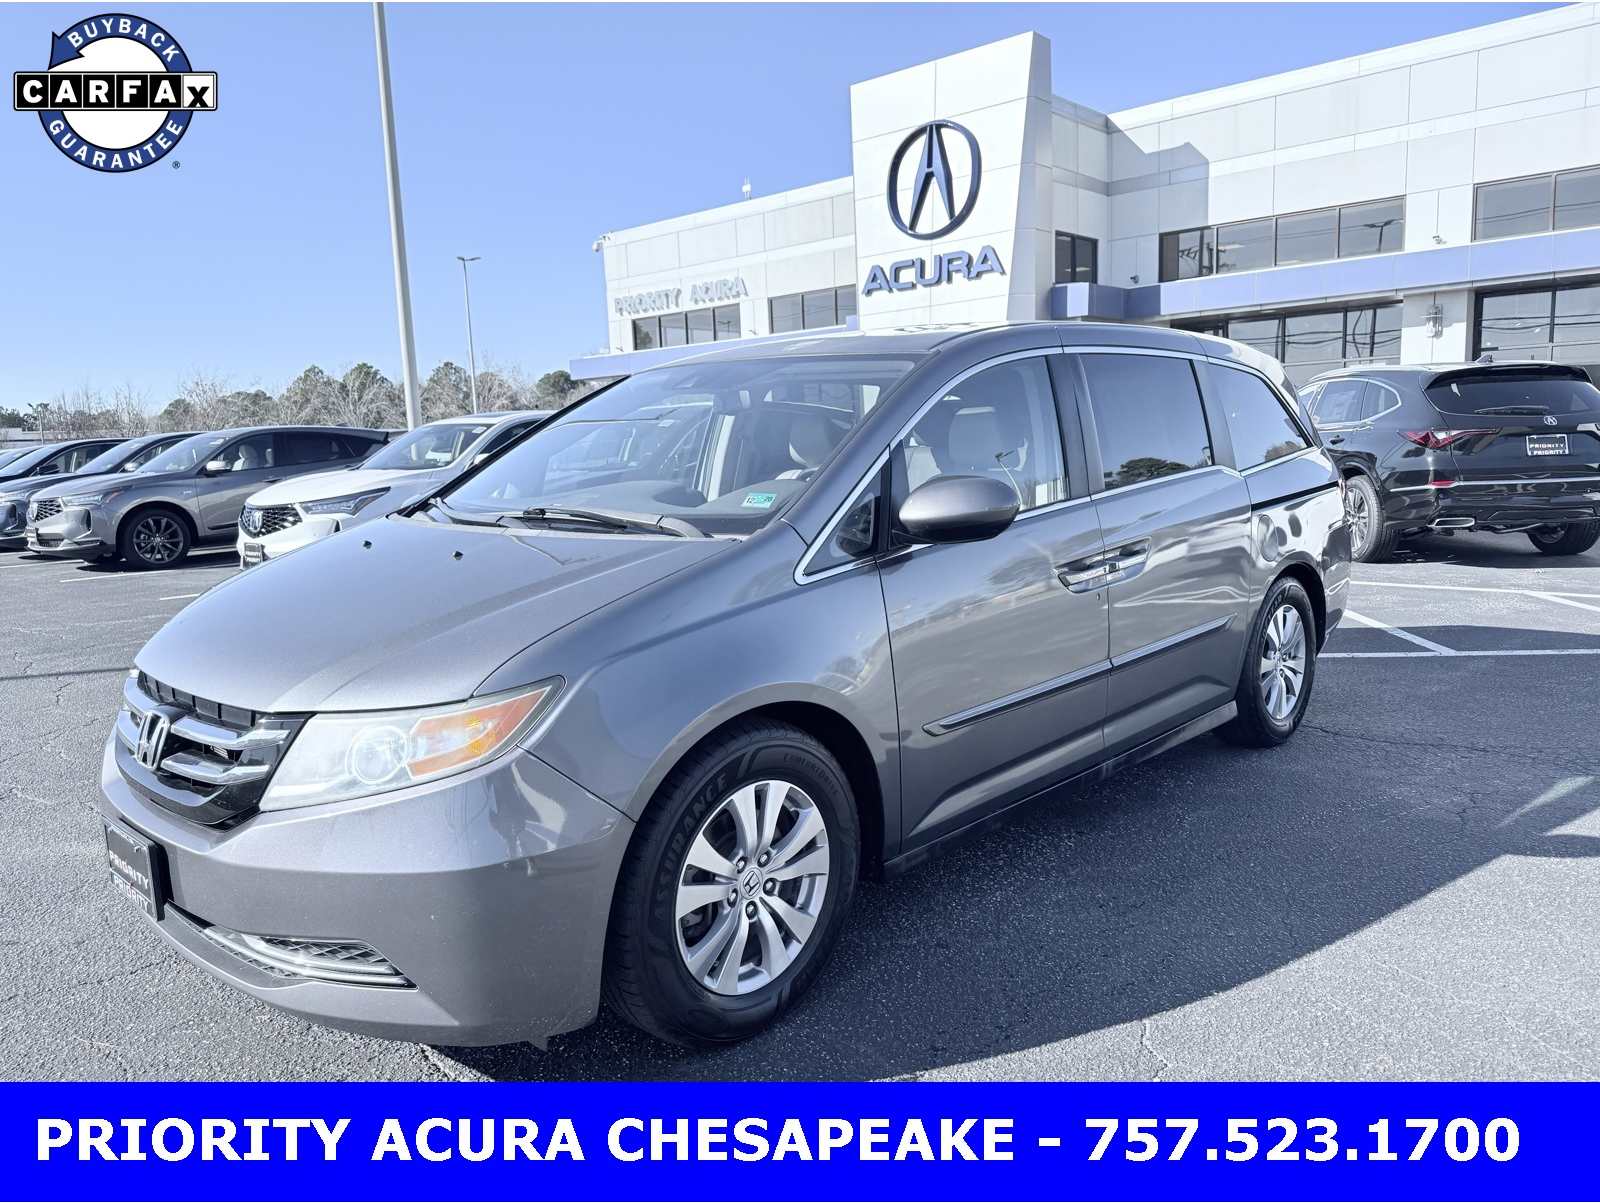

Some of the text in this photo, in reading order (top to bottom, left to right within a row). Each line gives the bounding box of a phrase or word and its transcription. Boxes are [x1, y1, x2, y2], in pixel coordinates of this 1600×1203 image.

[861, 244, 1007, 297] ACURA
[614, 276, 749, 317] PRIORITY ACURA
[109, 849, 149, 889] PRIORITY
